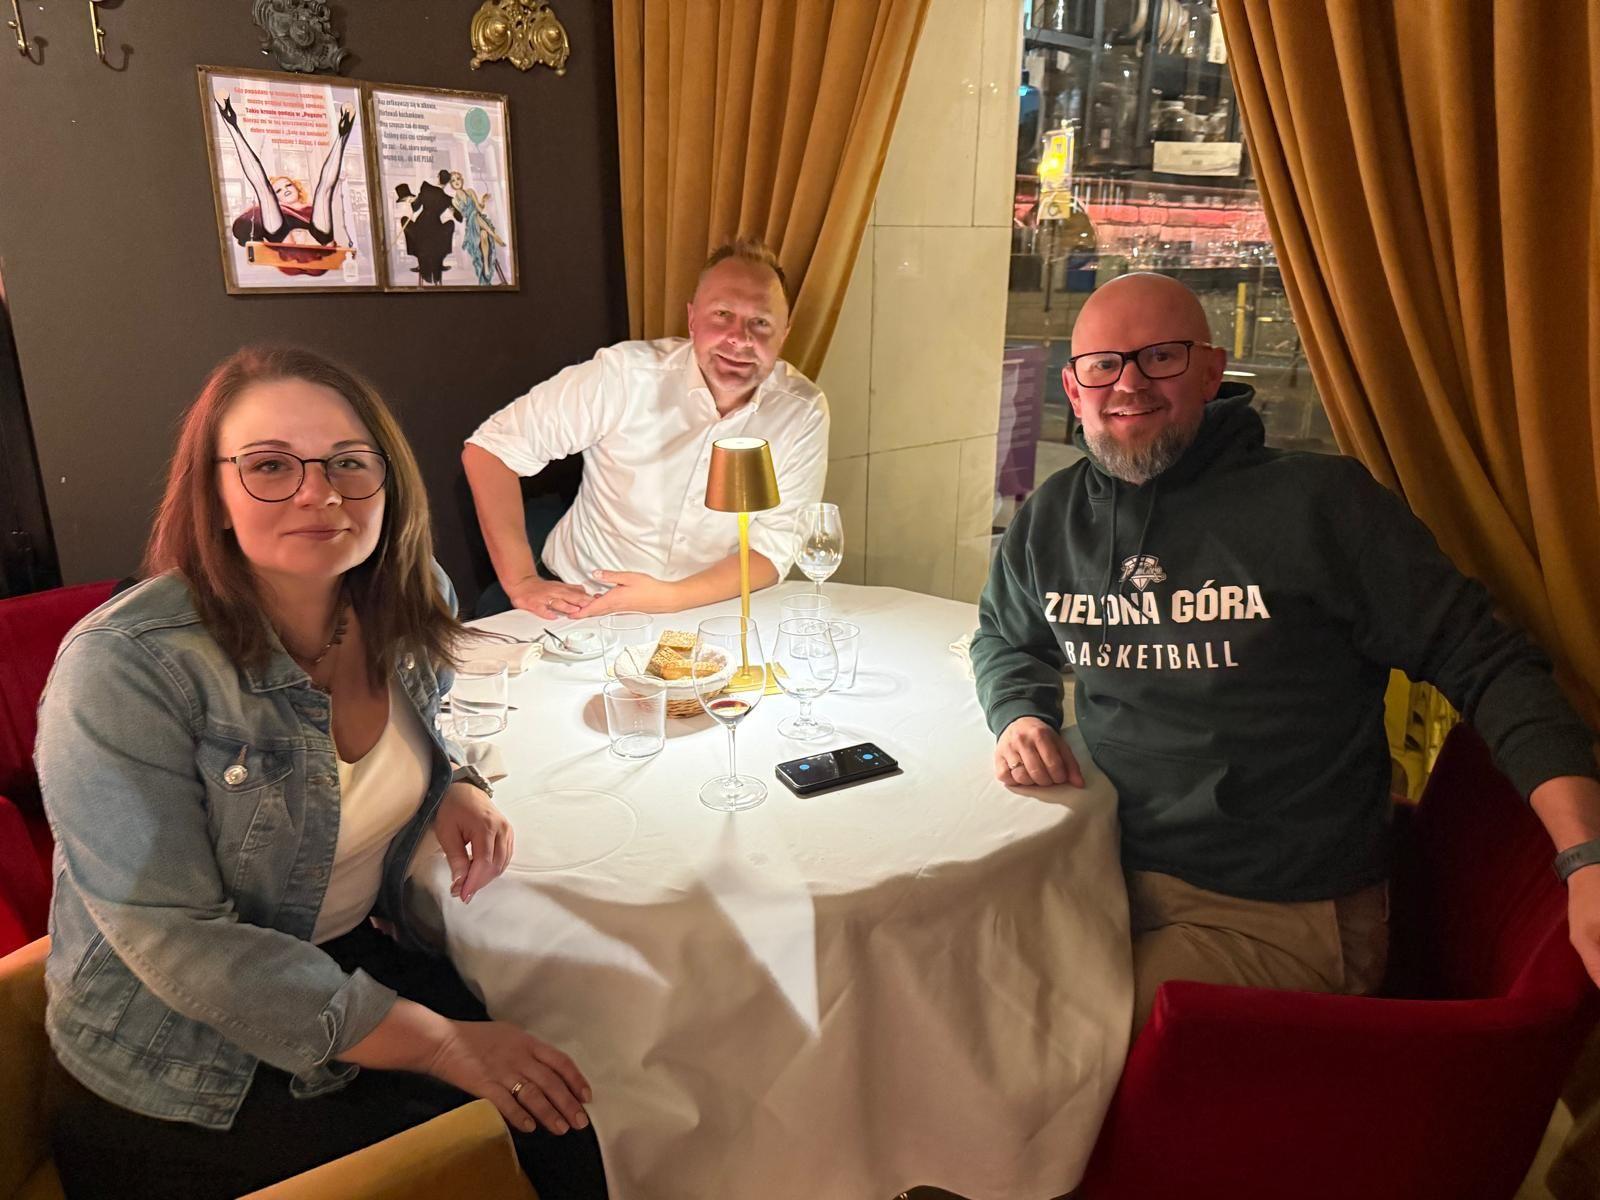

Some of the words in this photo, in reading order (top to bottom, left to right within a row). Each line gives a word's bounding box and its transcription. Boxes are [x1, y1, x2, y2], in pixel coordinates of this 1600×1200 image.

[1044, 591, 1161, 626] ZIELONA
[1171, 579, 1271, 623] GÓRA
[1064, 640, 1239, 670] BASKETBALL
